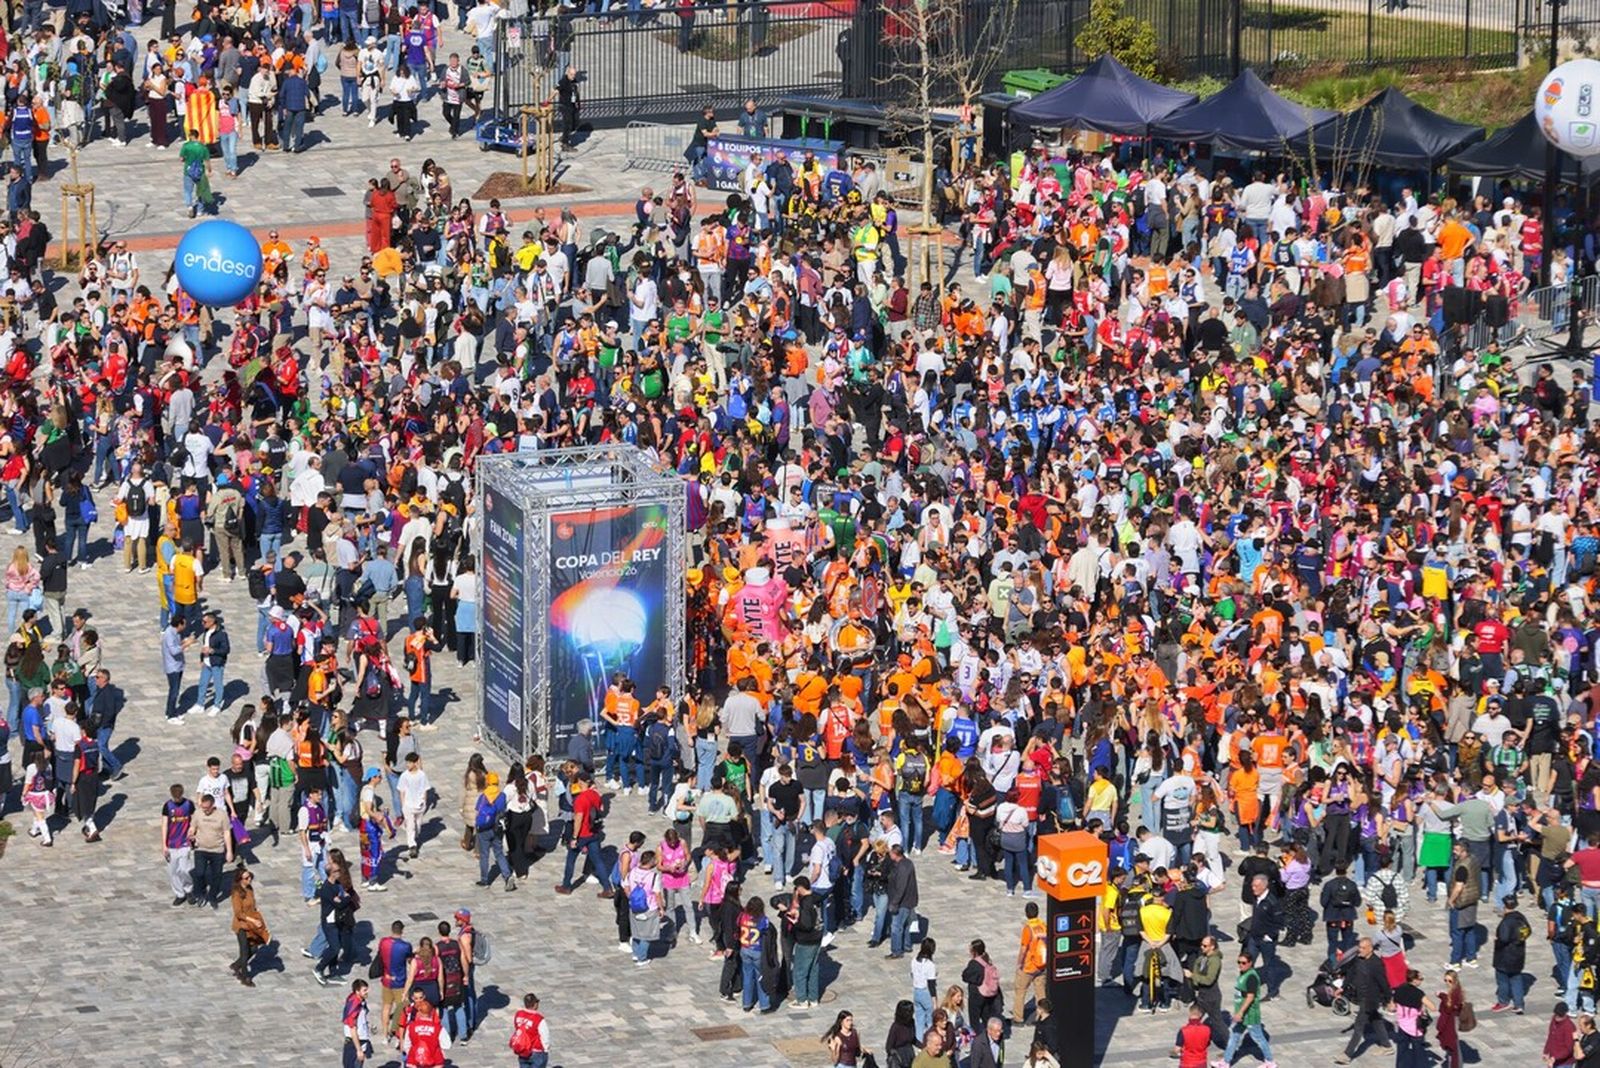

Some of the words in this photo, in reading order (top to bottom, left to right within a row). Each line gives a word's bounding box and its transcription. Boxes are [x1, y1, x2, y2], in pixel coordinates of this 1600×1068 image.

[725, 143, 762, 154] EQUIPOS
[720, 180, 741, 190] GAN
[183, 252, 256, 279] endesa
[490, 519, 502, 538] FAN
[501, 527, 518, 550] ZONE
[555, 553, 599, 569] COPA
[601, 551, 630, 565] DEL
[632, 547, 662, 562] REY
[579, 566, 624, 580] Valencia
[963, 665, 971, 679] 3
[804, 747, 814, 762] 8
[1066, 860, 1103, 887] C2
[739, 926, 760, 945] 22
